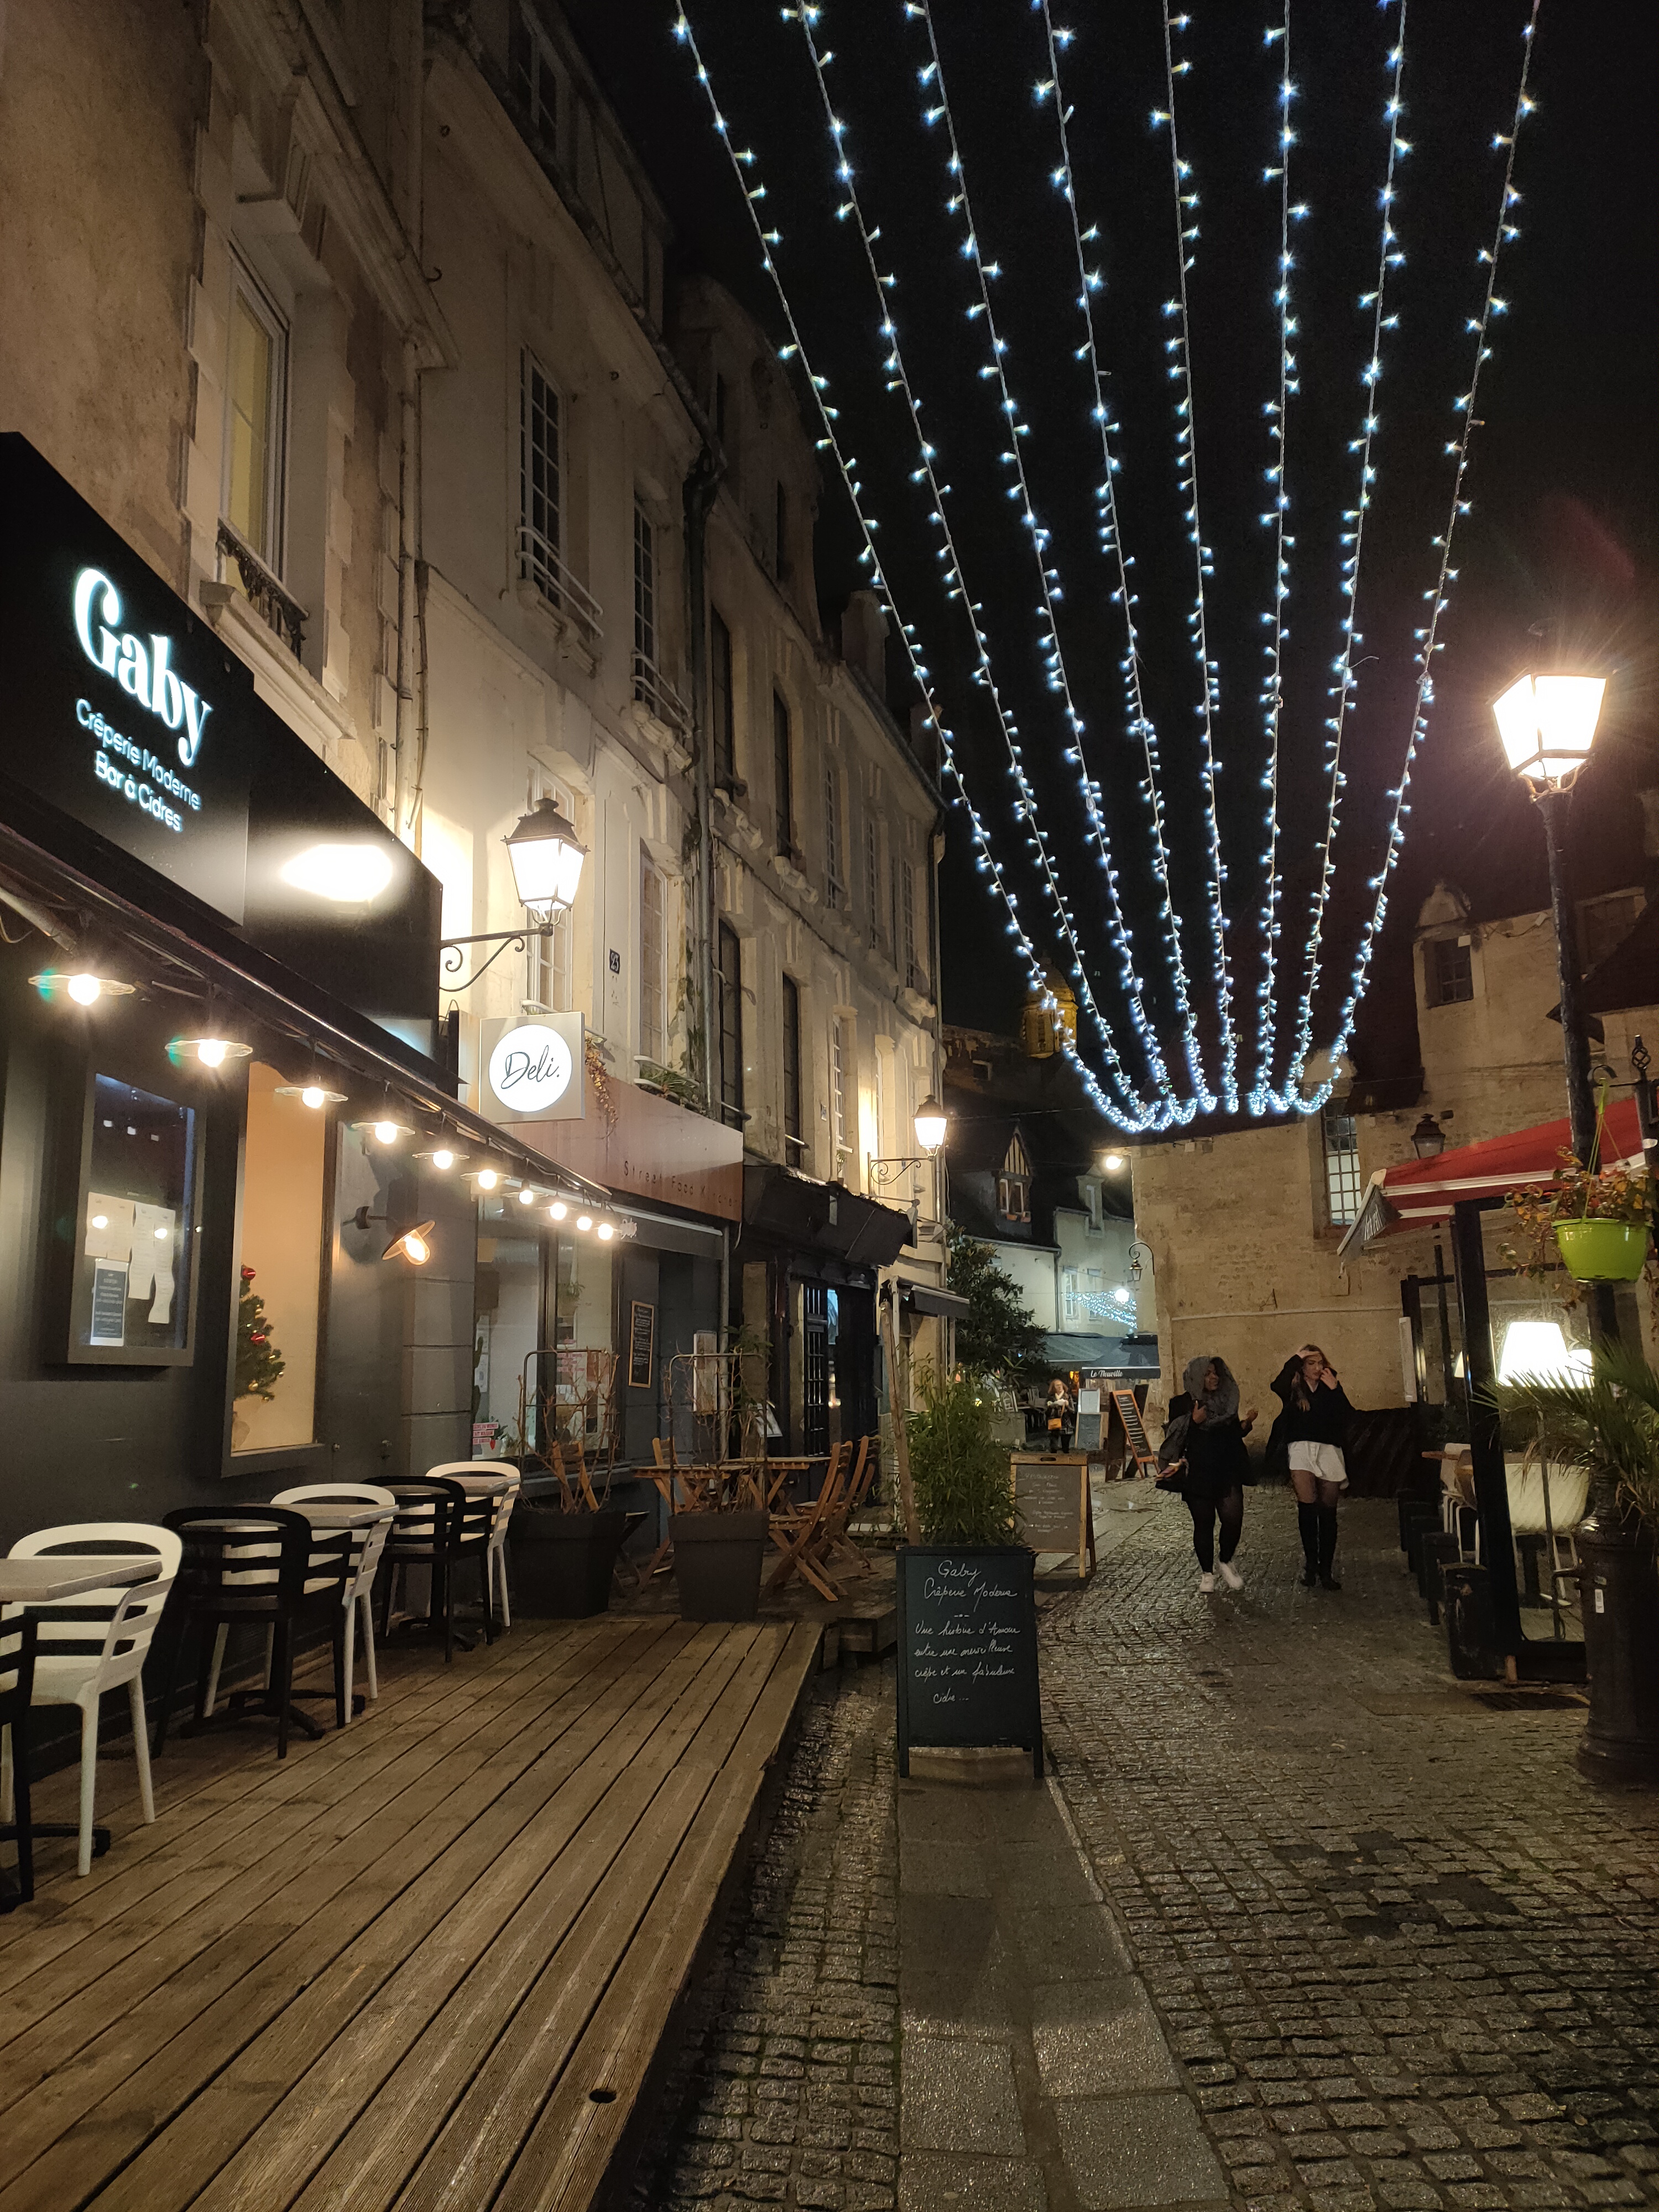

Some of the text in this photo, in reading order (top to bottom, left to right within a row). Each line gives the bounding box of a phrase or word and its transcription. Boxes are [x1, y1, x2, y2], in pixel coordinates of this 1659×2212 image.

[74, 567, 213, 767] Gaby
[76, 698, 202, 811] Crêperie Moderne
[95, 749, 183, 833] Bar à Cidres
[610, 950, 619, 972] 23
[624, 1160, 662, 1185] Street
[938, 1559, 982, 1587] Gaby
[924, 1577, 1018, 1613] Crêperie Moderne
[915, 1620, 933, 1634] Une
[938, 1620, 974, 1636] histoire
[914, 1639, 1013, 1657] entre une merveilleuse
[915, 1666, 937, 1683] crêpe
[941, 1666, 951, 1676] et
[972, 1661, 1015, 1684] fabuleux
